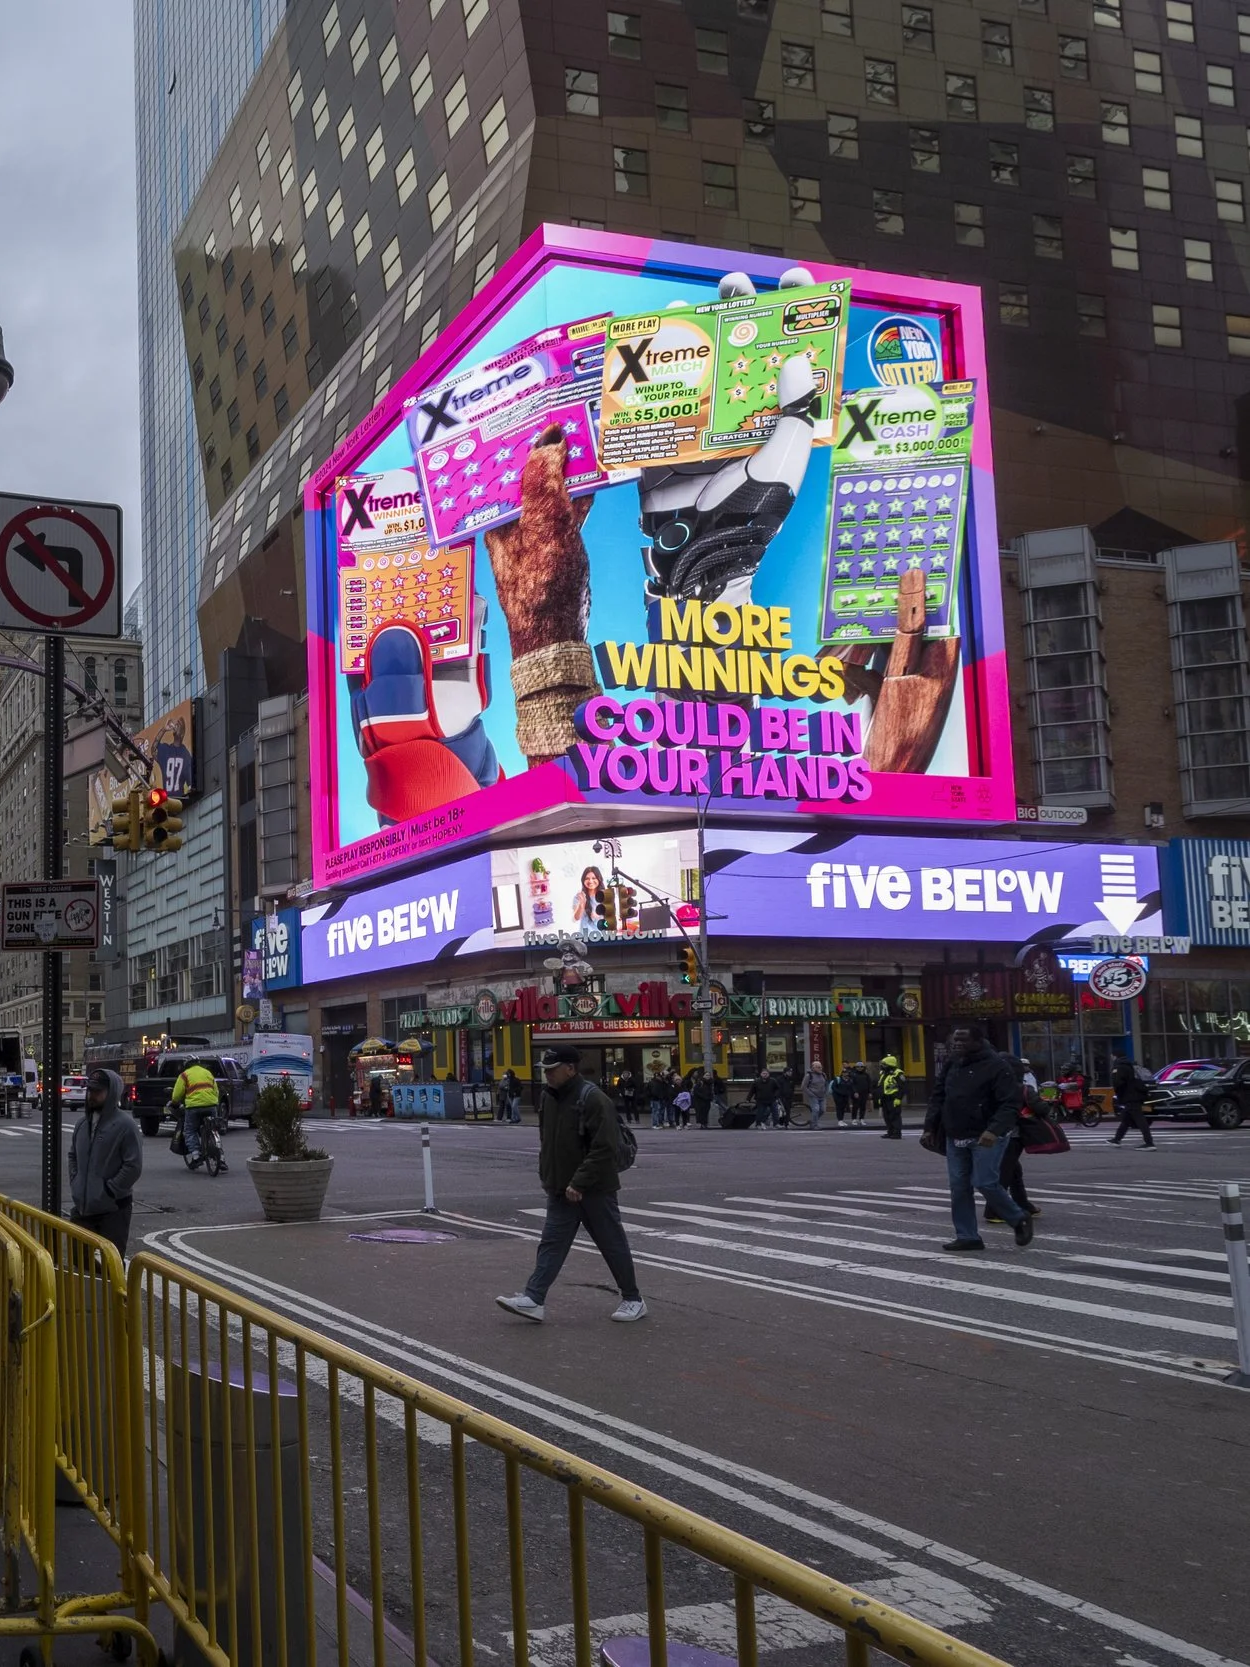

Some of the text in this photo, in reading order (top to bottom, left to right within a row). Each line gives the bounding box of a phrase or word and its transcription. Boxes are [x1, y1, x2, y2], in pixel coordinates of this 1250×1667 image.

[830, 282, 845, 293] $1
[696, 299, 756, 314] NEW YORK LOTTERY
[795, 309, 830, 321] MULTIPLIER
[724, 310, 773, 323] WINNING NUMBER
[612, 321, 636, 334] MORE
[638, 319, 658, 331] PLAY
[900, 326, 925, 340] NEW
[755, 338, 798, 350] YOUR NUMBERS
[903, 340, 934, 360] YORK
[609, 337, 710, 393] Xtreme
[651, 360, 703, 377] MATCH
[877, 361, 936, 386] LOTTERY
[635, 381, 683, 394] WIN UP TO
[644, 388, 698, 402] YOUR PRIZE
[416, 363, 532, 444] Xtreme
[610, 418, 620, 426] UP
[634, 403, 700, 423] $5,000!
[753, 417, 761, 428] 1
[838, 399, 936, 449] Xtreme
[880, 424, 929, 439] CASH
[332, 404, 386, 468] New York Lottery
[713, 430, 762, 442] SCRATCH TO
[895, 438, 964, 453] $3,000,000!
[338, 479, 347, 487] $5
[341, 482, 422, 536] Xtreme
[386, 522, 400, 530] WIN
[659, 597, 792, 649] MORE
[604, 640, 845, 699] WINNINGS
[584, 695, 862, 754] COULD BE IN
[166, 757, 184, 792] 97
[576, 743, 872, 800] YOUR HANDS
[1017, 808, 1084, 820] BIG OUTDOOR
[325, 807, 465, 870] PLEASE PLAY RESPONSIBLY Must be 18+
[432, 824, 463, 842] HOPENY
[806, 862, 1064, 914] five BELOW
[7, 897, 56, 908] THIS IS A
[99, 874, 114, 946] WESTIN
[7, 911, 29, 920] GUN
[327, 889, 459, 958] five BELOW
[7, 924, 35, 933] ZONE
[1091, 935, 1191, 954] five BELOW
[476, 1000, 496, 1014] villa
[501, 986, 558, 1022] villa
[573, 1000, 597, 1009] villa
[613, 981, 693, 1018] villa
[753, 999, 889, 1016] STROMBOLI PASTA
[400, 1012, 420, 1029] PIZZA
[540, 1019, 665, 1030] PIZZA PASTA CHEESESTEAKS
